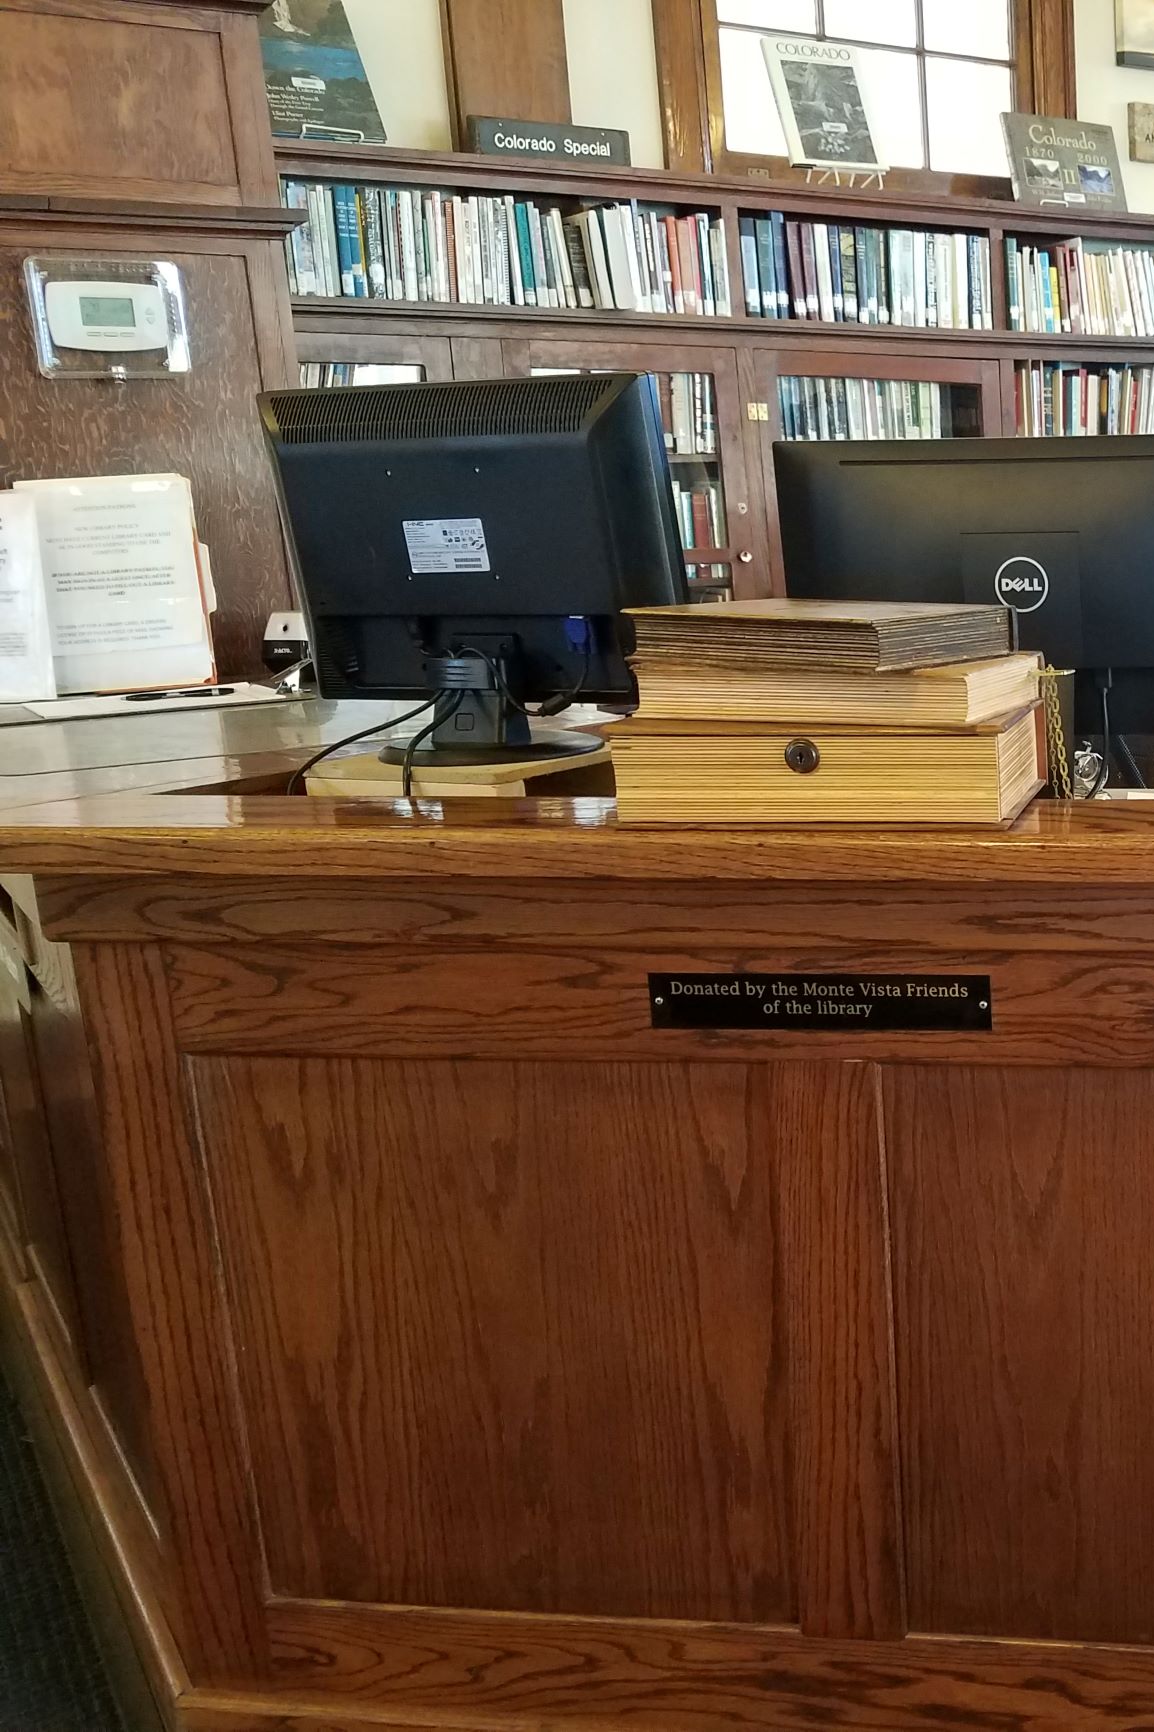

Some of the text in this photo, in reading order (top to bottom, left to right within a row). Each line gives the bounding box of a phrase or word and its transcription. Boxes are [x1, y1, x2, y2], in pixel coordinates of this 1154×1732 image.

[776, 42, 851, 61] COLORADO
[494, 133, 611, 157] Colorado Special
[1028, 124, 1097, 151] Colorado
[1025, 146, 1108, 166] 1870 2000
[1001, 577, 1042, 592] DELL
[670, 981, 969, 998] Donated by the Monte Vista Friends
[763, 1000, 873, 1018] of the library
